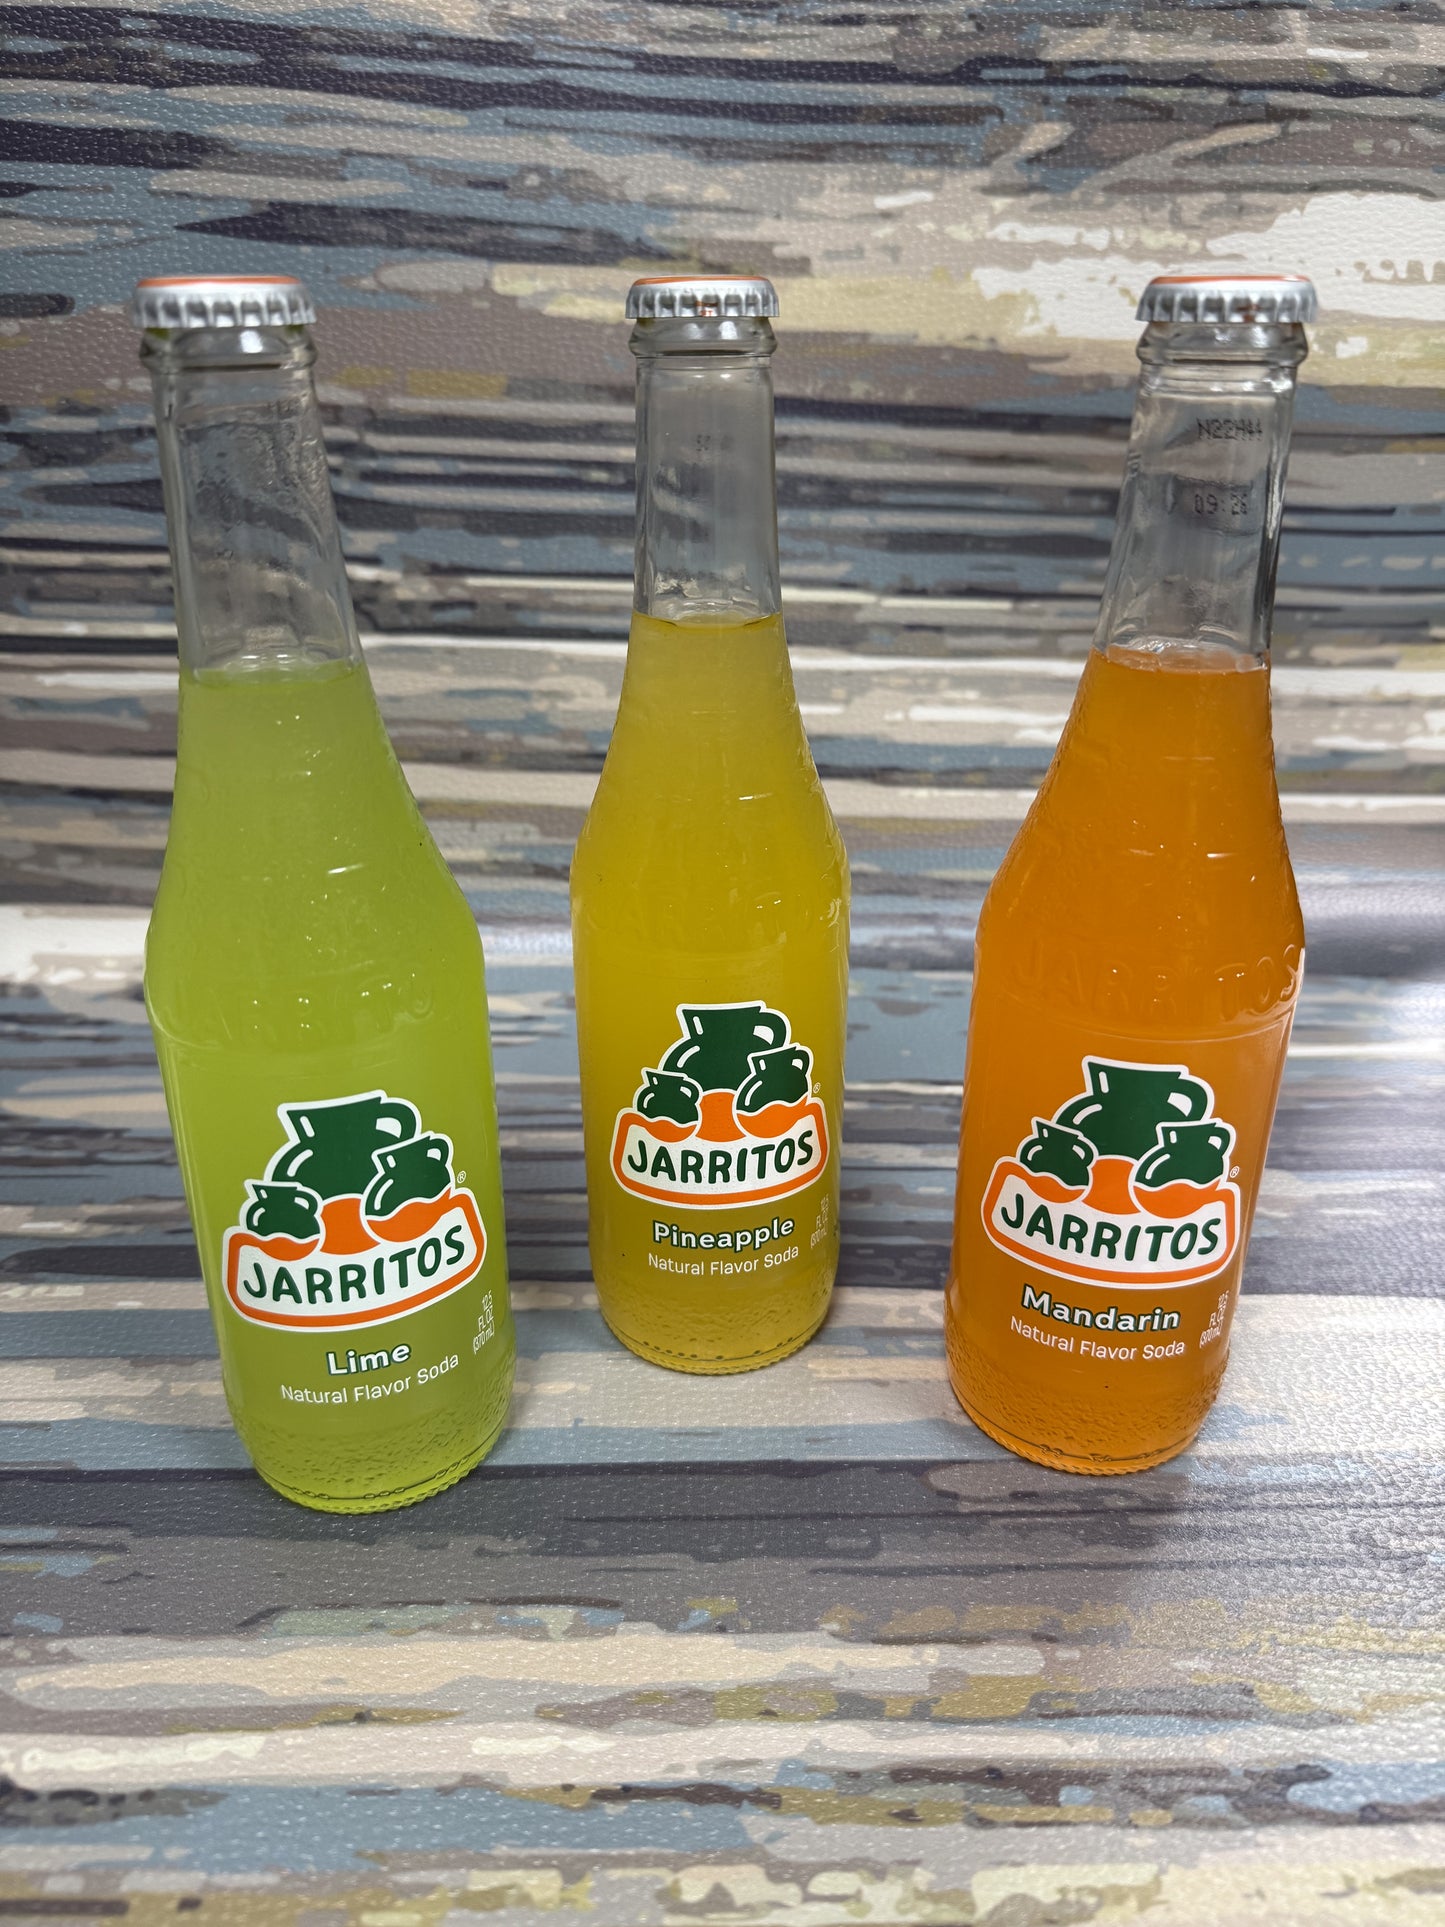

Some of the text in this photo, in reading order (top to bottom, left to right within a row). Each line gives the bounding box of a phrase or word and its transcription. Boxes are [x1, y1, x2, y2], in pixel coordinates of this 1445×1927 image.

[1009, 936, 1299, 1021] JARRTOS
[626, 1130, 814, 1185] JARRITOS
[652, 1216, 795, 1252] Pineapple
[1000, 1193, 1221, 1262] JARRITOS
[242, 1224, 466, 1305] JARRITOS
[647, 1245, 800, 1276] Natural Flavor Soda
[478, 1315, 487, 1332] FL
[1021, 1283, 1181, 1332] Mandarin
[326, 1343, 413, 1376] Lime
[1010, 1314, 1186, 1361] Natural Flavor Soda
[281, 1353, 459, 1404] Natural Flavor Soda
